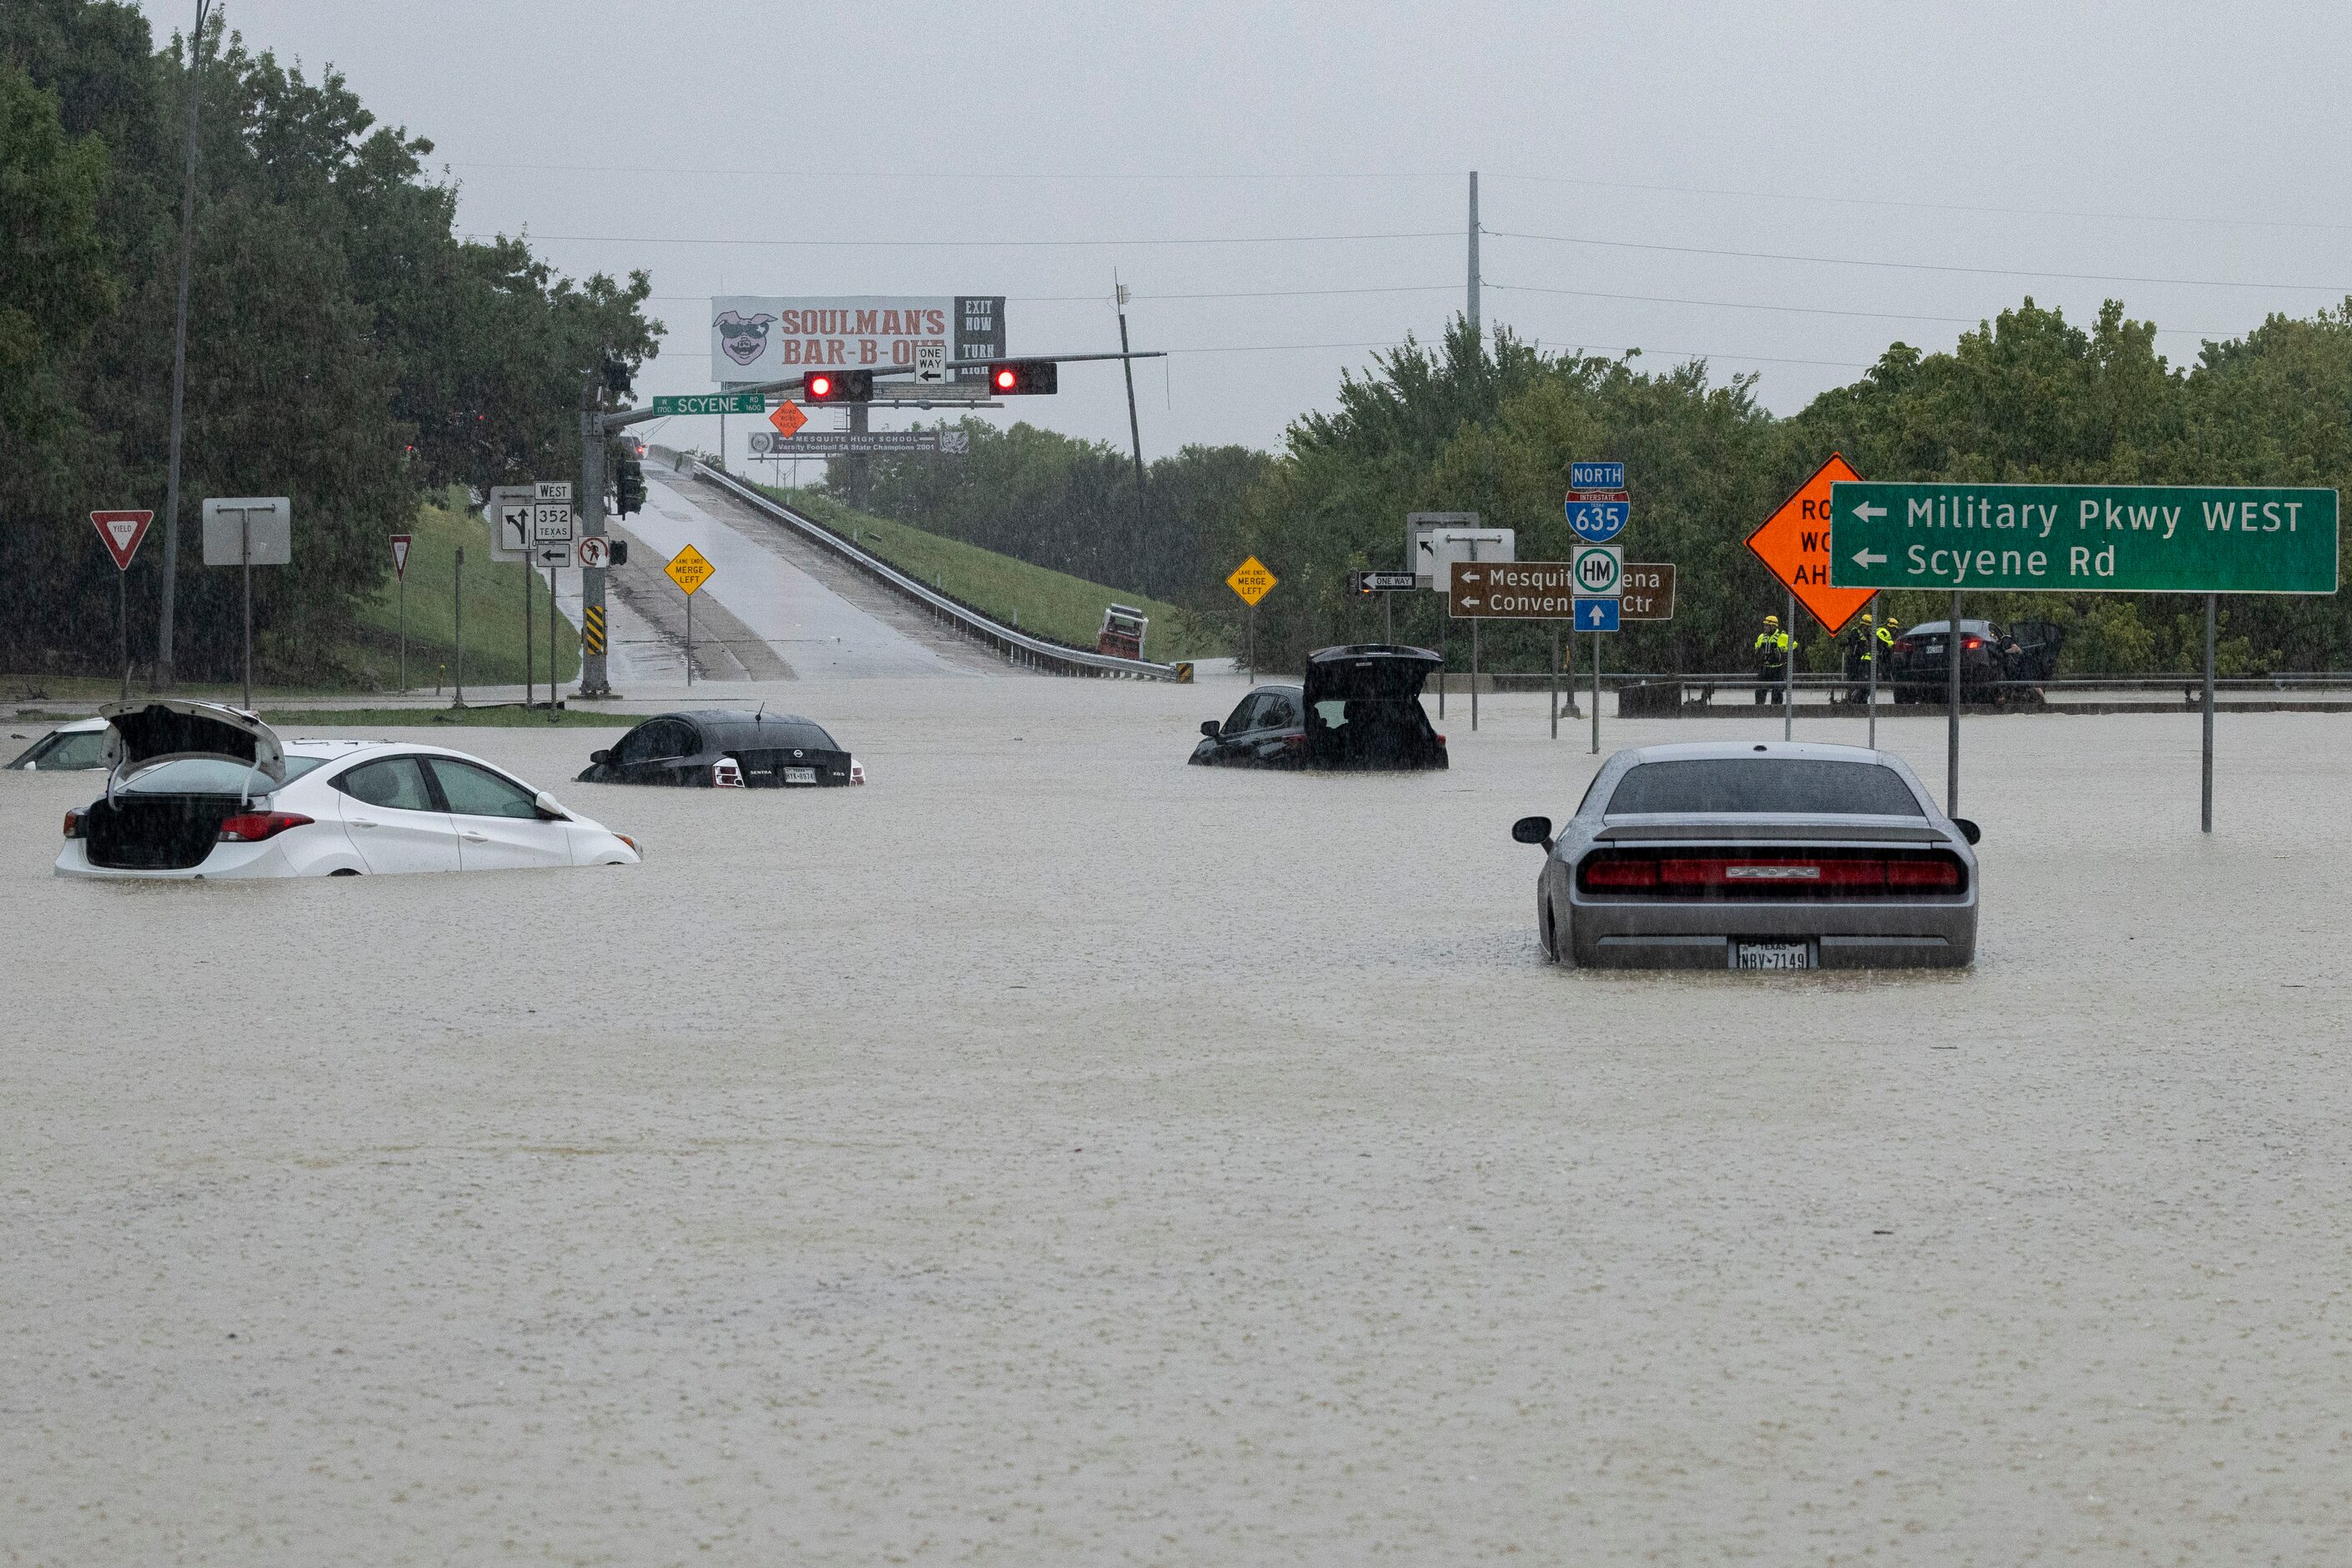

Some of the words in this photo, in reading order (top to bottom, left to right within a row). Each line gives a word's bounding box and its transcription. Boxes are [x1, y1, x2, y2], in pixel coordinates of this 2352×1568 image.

[965, 301, 992, 314] EXIT
[781, 309, 945, 335] SOULMAN'S
[965, 317, 992, 331] NOW
[920, 349, 941, 358] ONE
[963, 344, 994, 358] TURN
[919, 360, 942, 368] WAY
[678, 397, 740, 412] SCYENE
[1574, 468, 1621, 483] NORTH
[539, 484, 567, 498] WEST
[539, 510, 568, 523] 352
[1802, 499, 1831, 520] RO
[1907, 495, 2058, 538] Military
[2080, 498, 2182, 539] Pkwy
[2202, 501, 2303, 532] WEST
[1576, 508, 1619, 531] 635
[113, 524, 132, 533] YIELD
[1801, 532, 1830, 552] WO
[1907, 544, 2047, 583] Scyene
[2070, 544, 2115, 576] Rd
[1583, 561, 1611, 582] HM
[1376, 577, 1393, 585] ONE
[1394, 577, 1410, 585] WAY
[1490, 569, 1571, 592] Mesquit
[1622, 595, 1653, 612] Ctr
